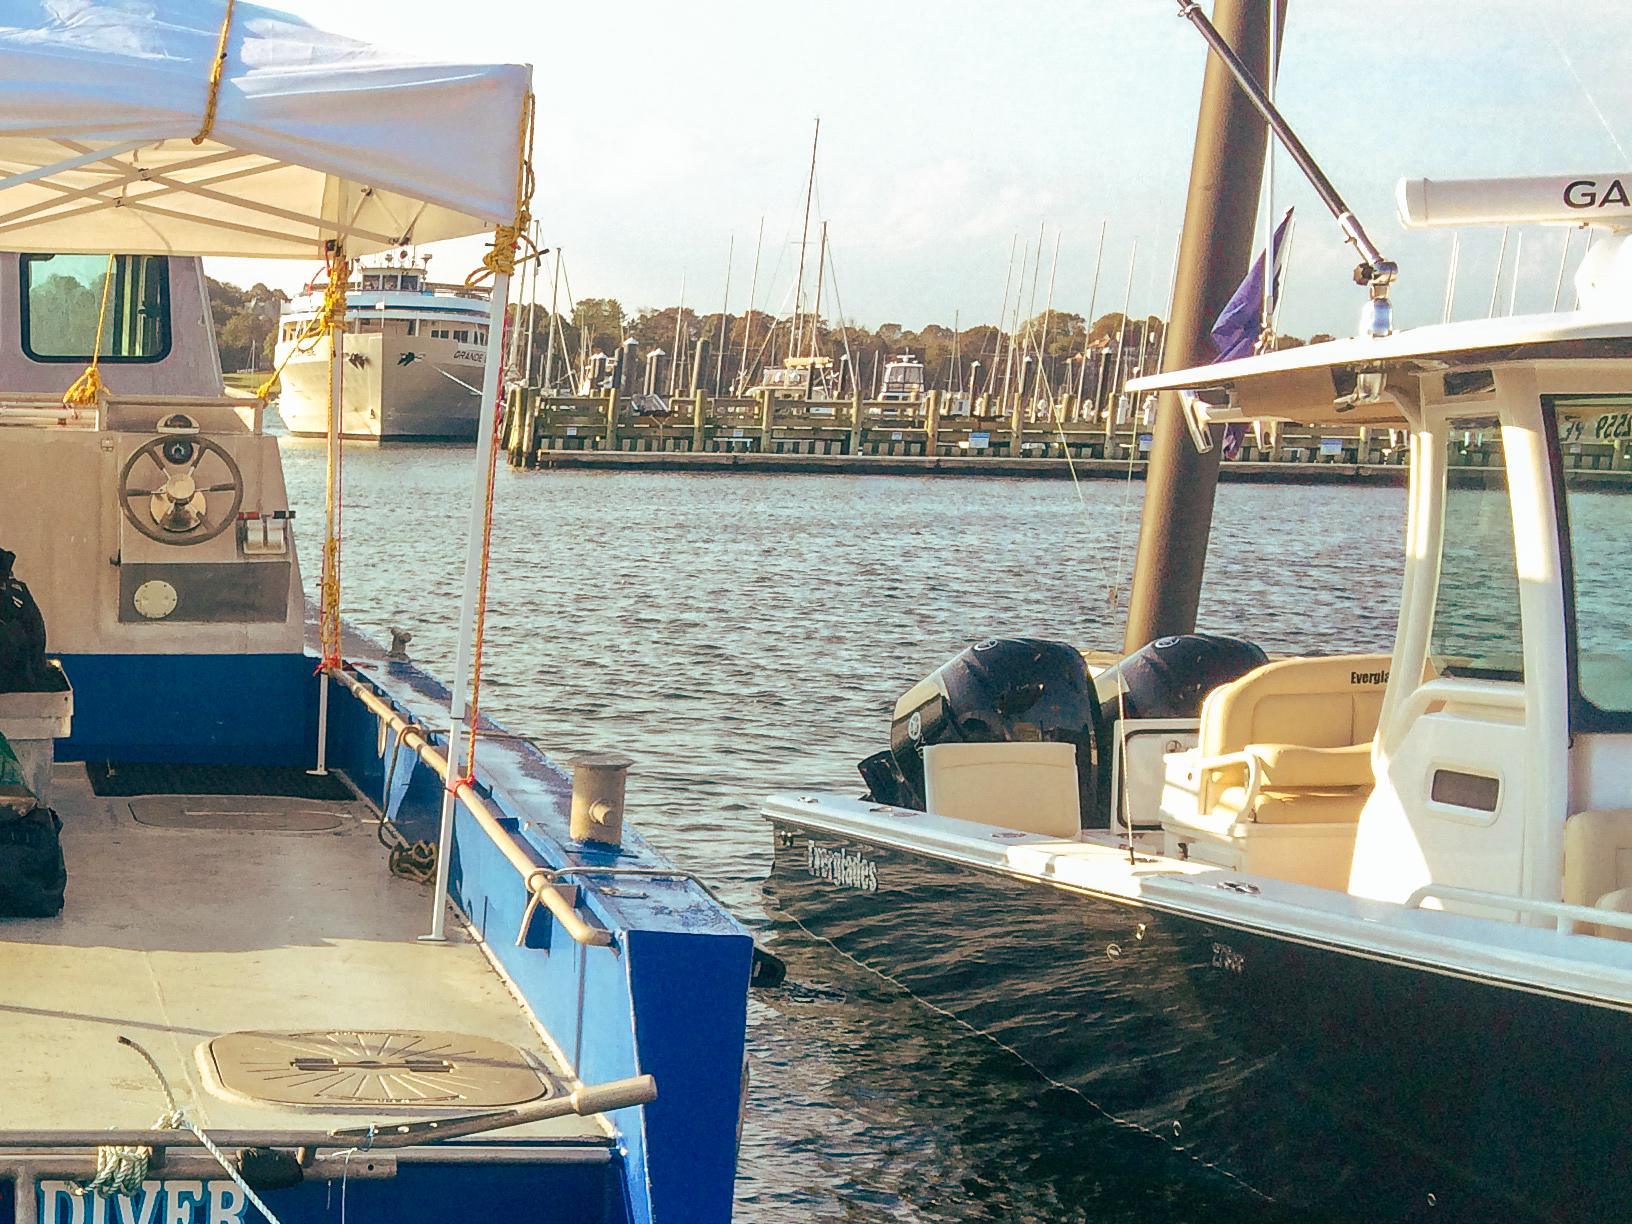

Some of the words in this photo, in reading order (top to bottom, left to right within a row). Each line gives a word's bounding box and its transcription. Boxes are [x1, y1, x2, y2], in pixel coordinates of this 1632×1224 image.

[1563, 179, 1631, 209] GA
[453, 350, 484, 363] GRANDE
[808, 839, 879, 892] Everglades
